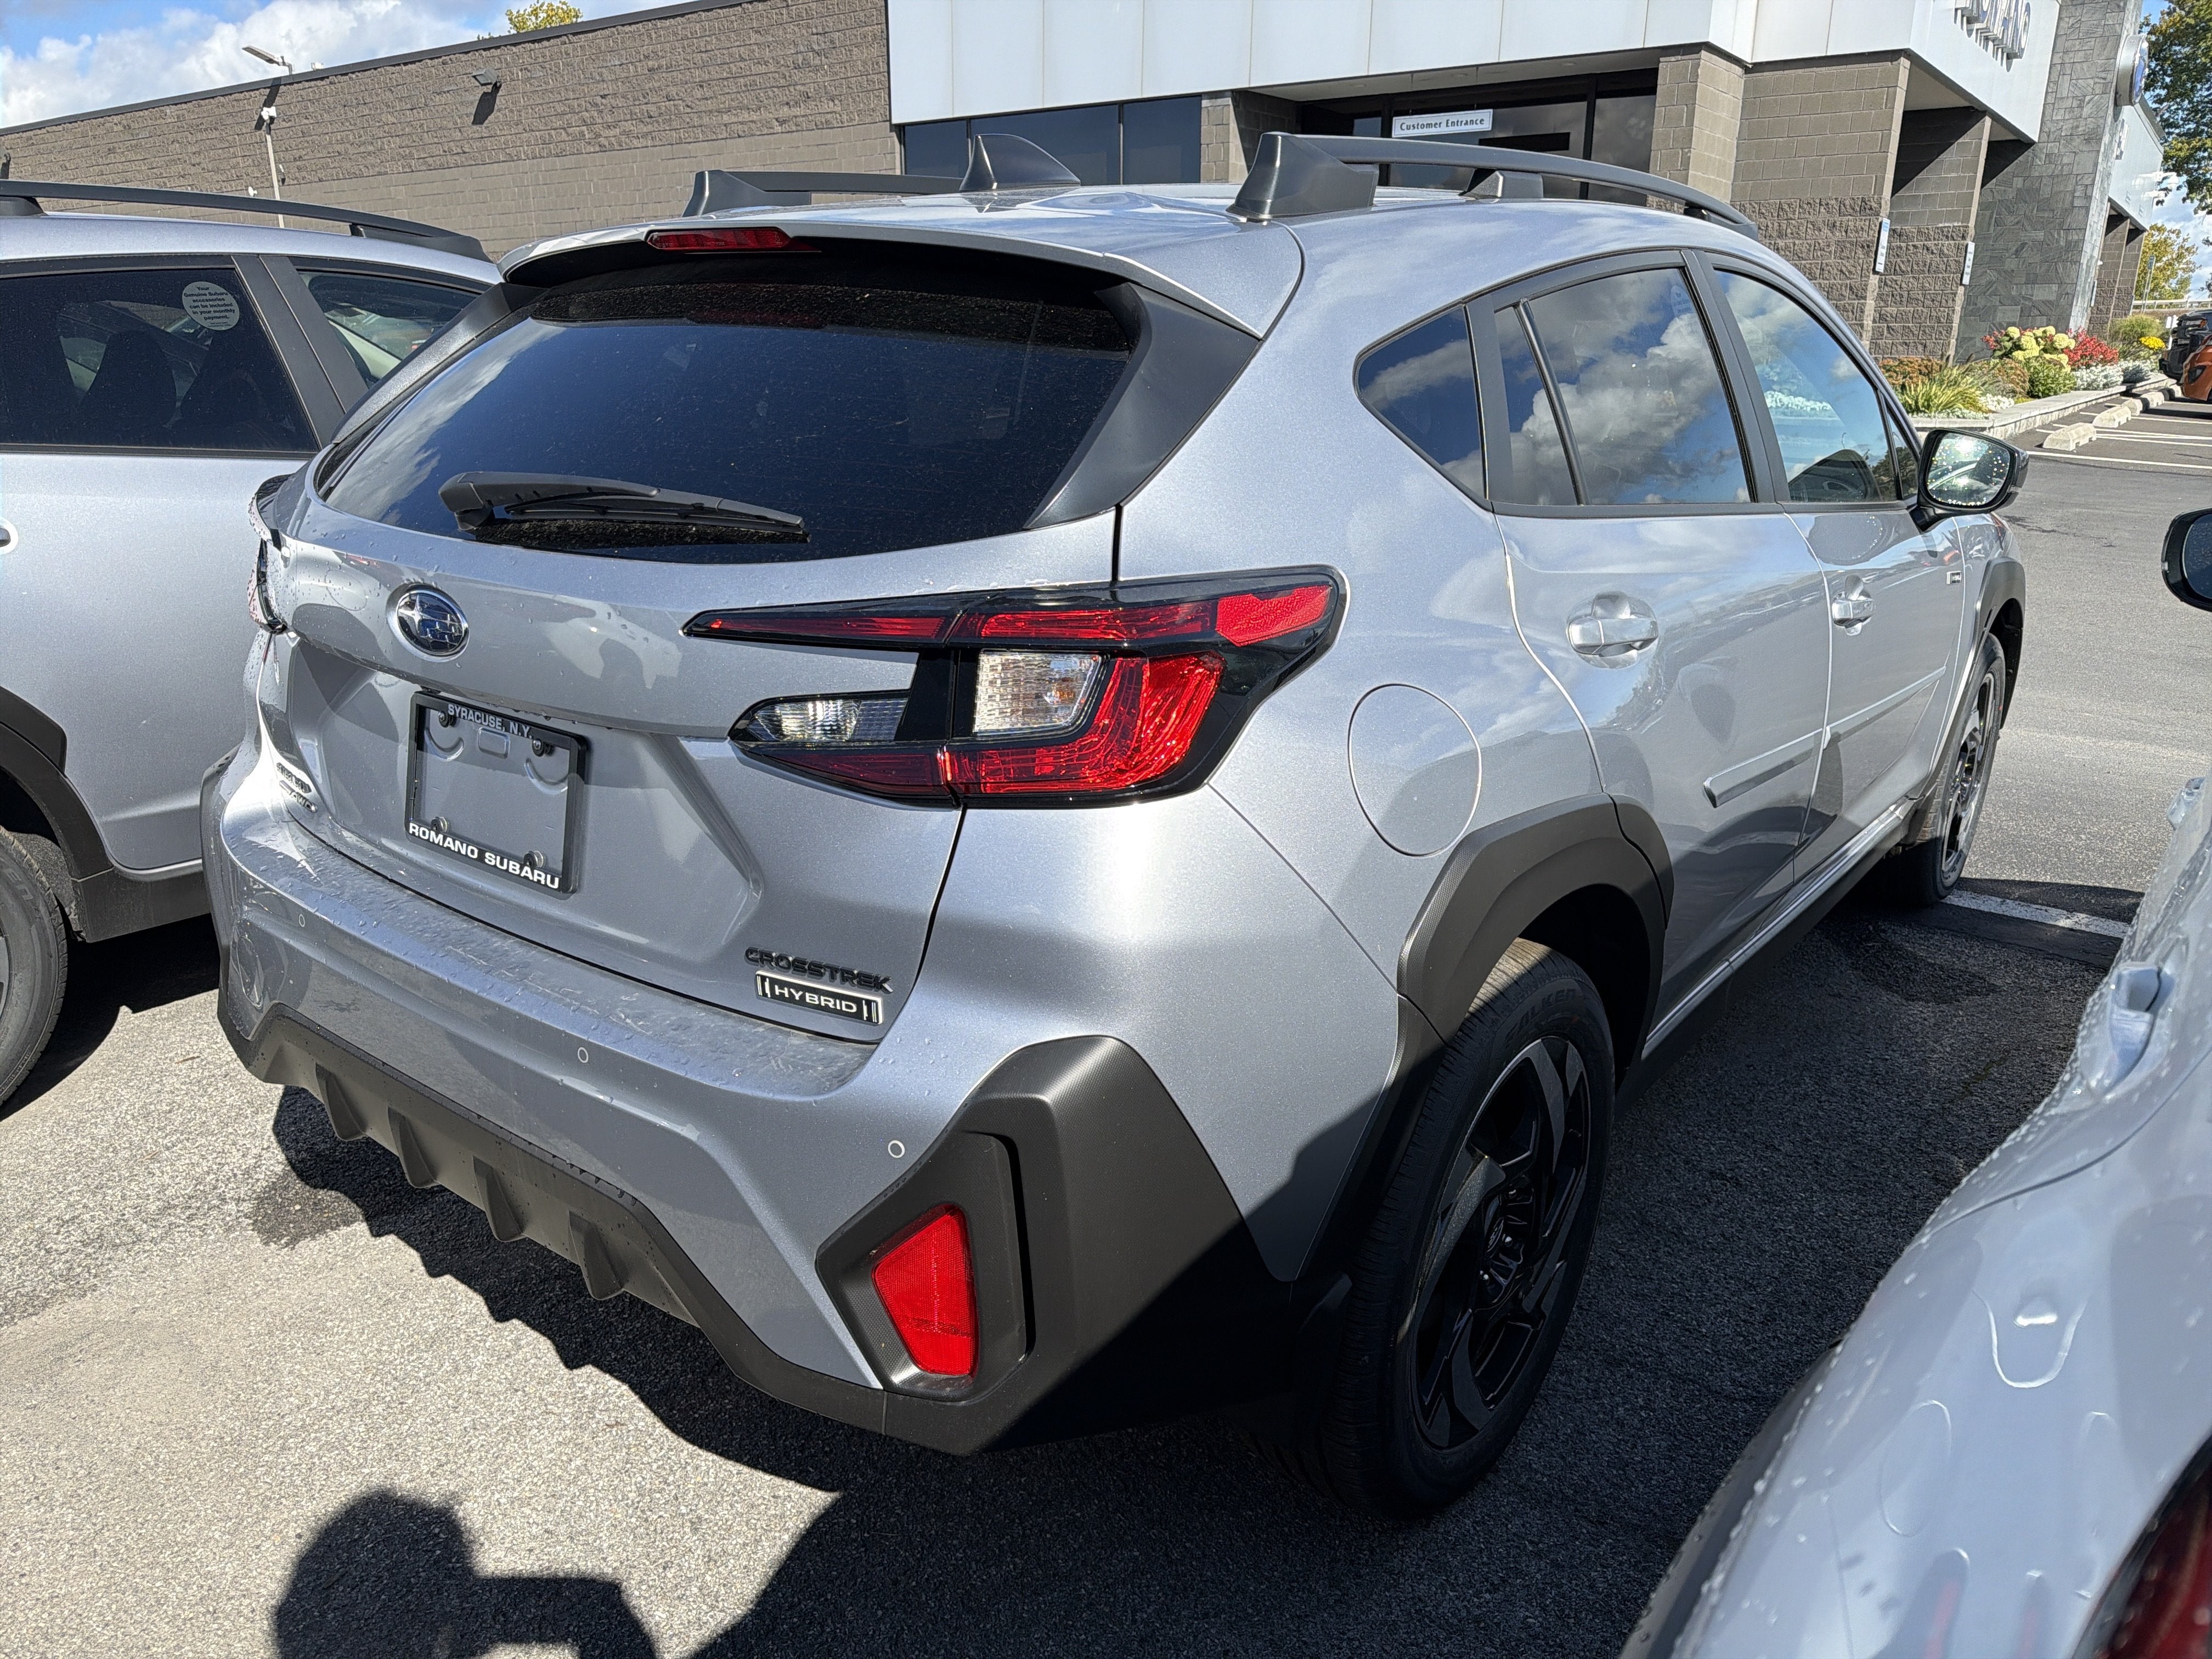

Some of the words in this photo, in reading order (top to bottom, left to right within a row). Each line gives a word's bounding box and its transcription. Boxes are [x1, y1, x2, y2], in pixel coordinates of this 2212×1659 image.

[1400, 121, 1443, 132] Customer
[1446, 117, 1485, 128] Entrance
[447, 703, 505, 732] SYRACUSE,
[509, 721, 533, 740] N.Y.
[409, 822, 478, 859] ROMANO
[484, 852, 560, 889] SUBARU
[744, 946, 894, 994] CROSSTREK
[774, 984, 857, 1013] HYBRID
